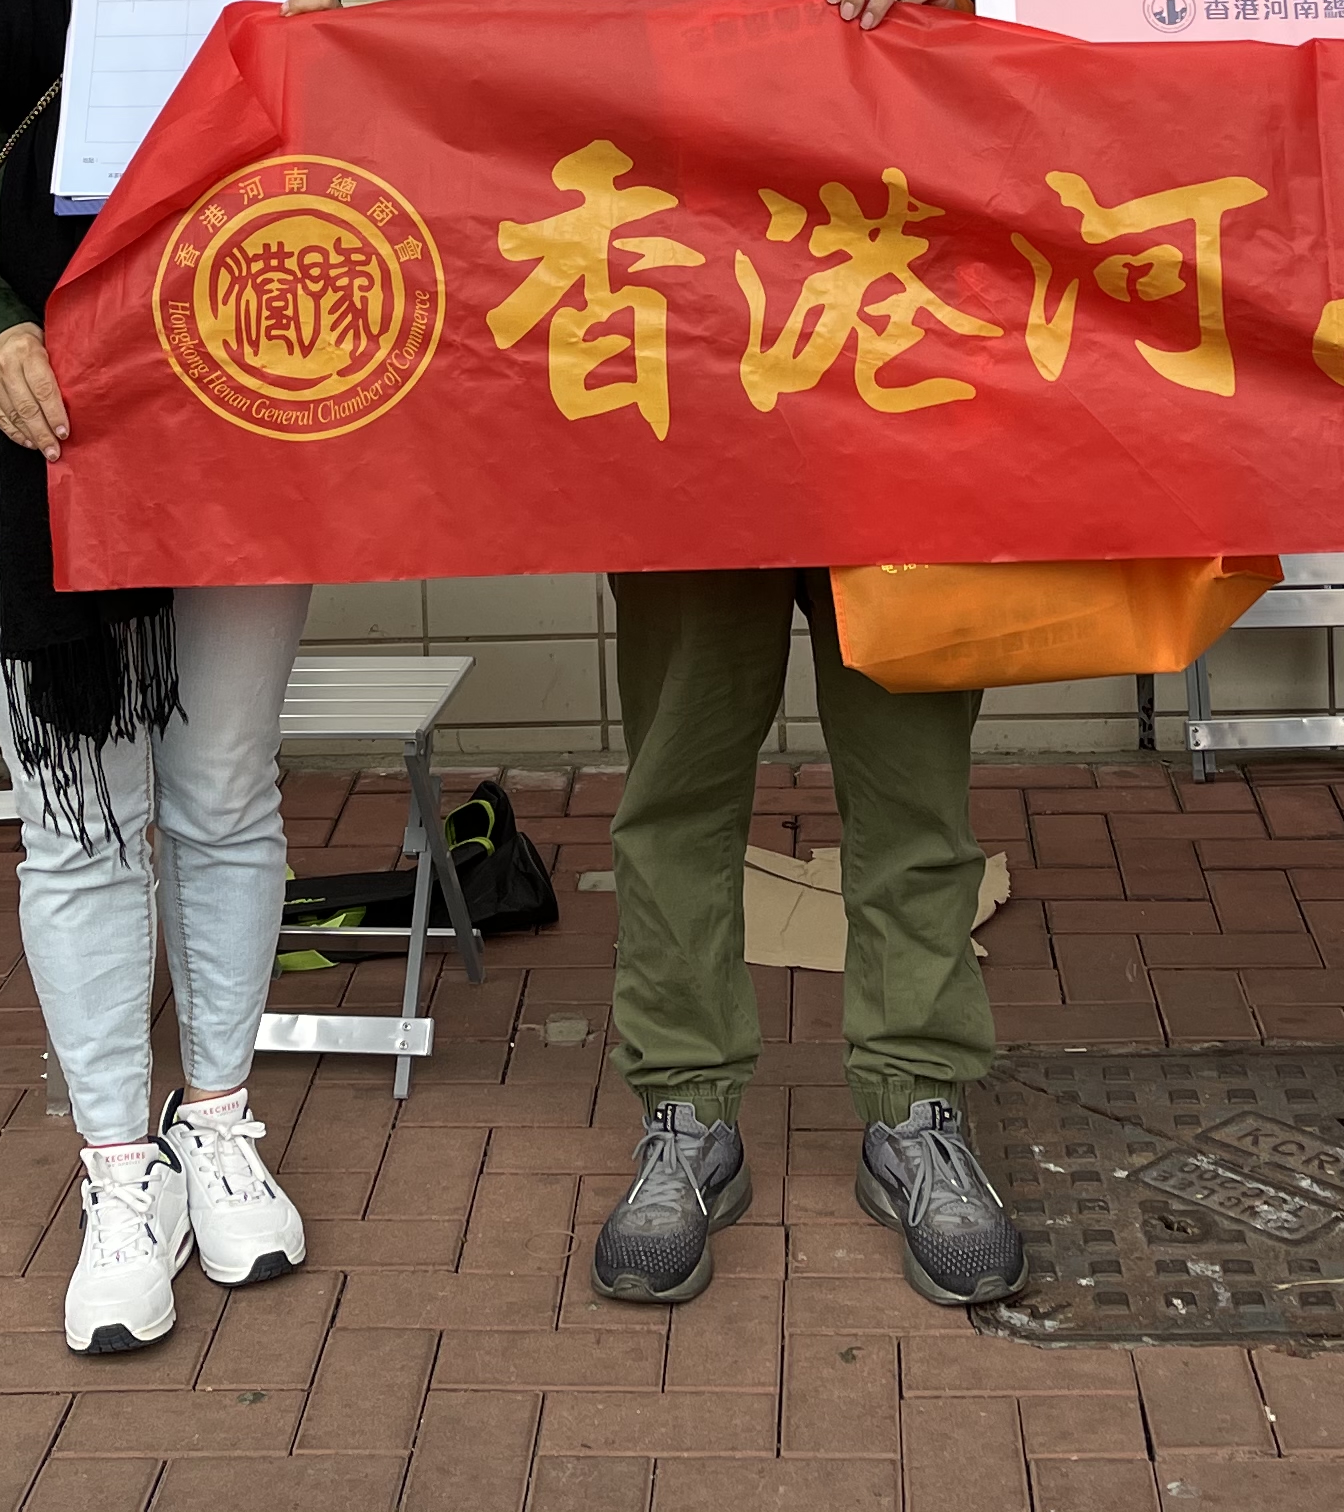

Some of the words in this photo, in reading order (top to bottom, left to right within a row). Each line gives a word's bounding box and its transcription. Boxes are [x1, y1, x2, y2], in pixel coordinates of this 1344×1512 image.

[174, 167, 423, 269] 香港河南總商會
[167, 300, 209, 378] Hongkong
[391, 289, 431, 371] Commerce
[203, 369, 251, 412] Henan
[383, 363, 403, 390] of
[251, 398, 313, 426] General
[317, 380, 383, 424] Chamber
